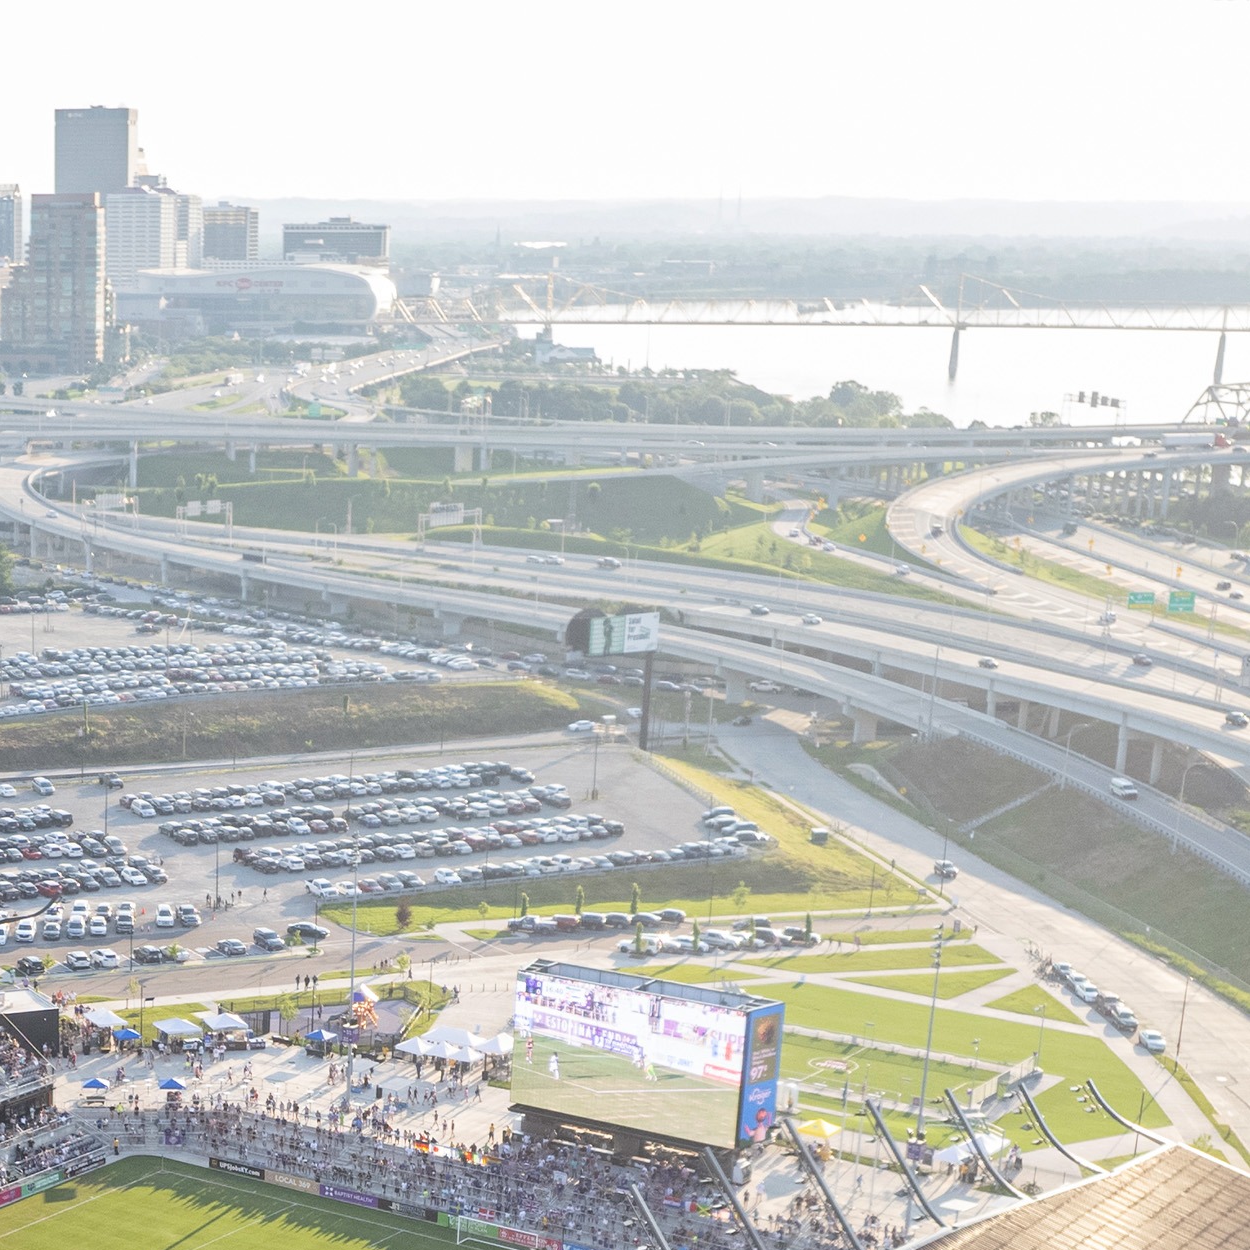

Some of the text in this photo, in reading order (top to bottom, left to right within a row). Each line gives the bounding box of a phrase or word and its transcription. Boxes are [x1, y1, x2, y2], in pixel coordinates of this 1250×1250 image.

[749, 1087, 772, 1105] Kroger
[275, 1174, 311, 1189] LOCAL 369
[333, 1190, 373, 1203] BAPTIST HEALTH
